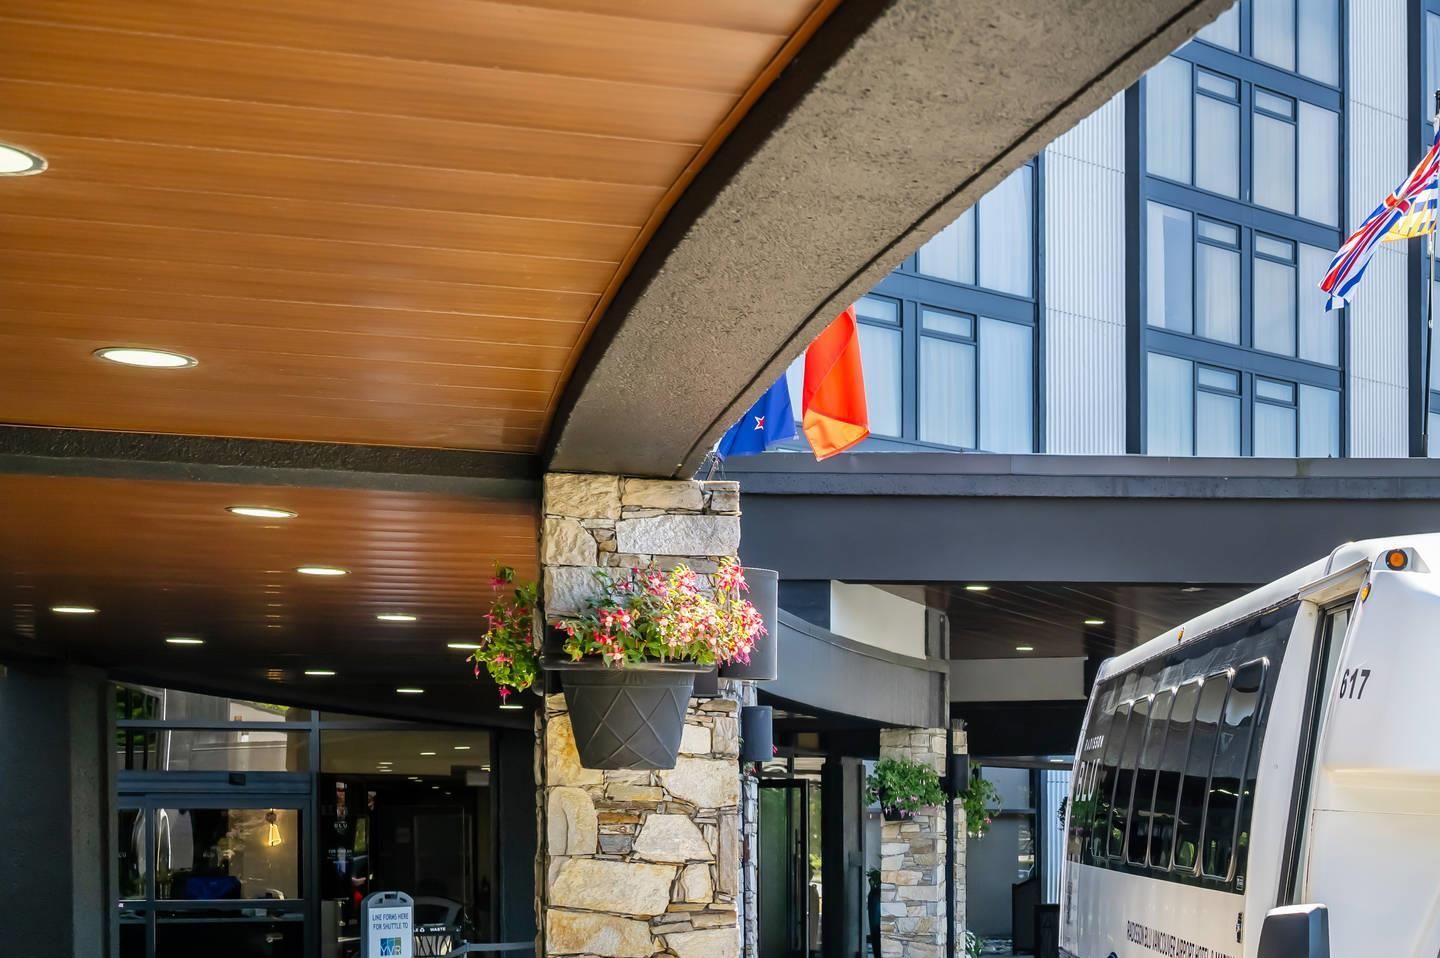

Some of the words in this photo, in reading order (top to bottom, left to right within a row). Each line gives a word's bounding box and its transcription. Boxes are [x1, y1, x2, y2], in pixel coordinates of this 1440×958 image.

[1340, 668, 1371, 700] 617
[1075, 758, 1101, 802] BLU
[383, 922, 401, 930] SHUTTLE
[402, 921, 409, 929] TO
[381, 946, 401, 955] YVR
